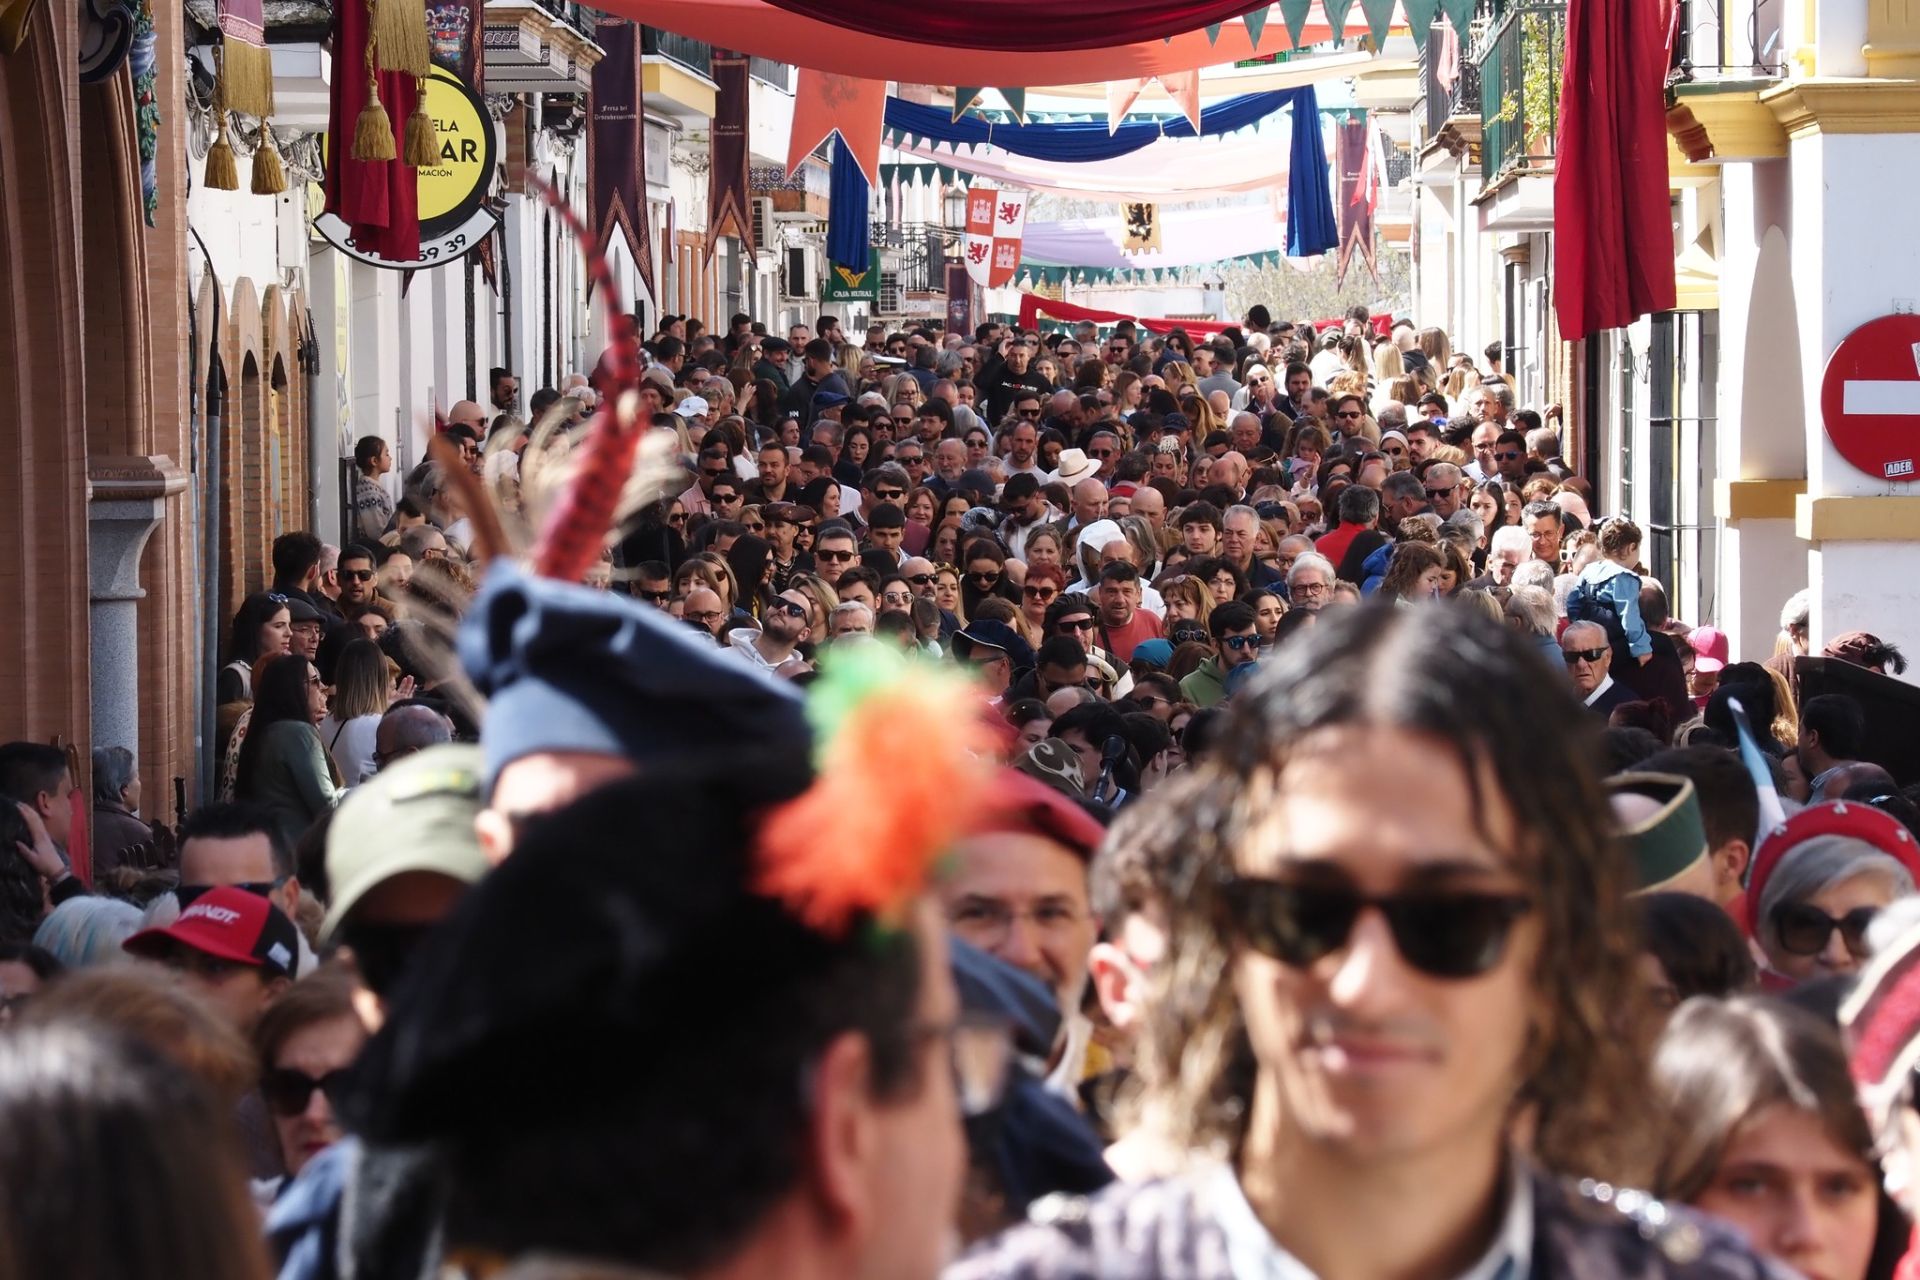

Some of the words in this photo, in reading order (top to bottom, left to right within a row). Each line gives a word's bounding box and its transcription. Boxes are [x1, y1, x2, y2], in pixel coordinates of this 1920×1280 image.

[444, 233, 466, 253] 39
[833, 290, 850, 298] CAJA
[850, 290, 875, 298] RURAL
[1887, 461, 1912, 475] ADER
